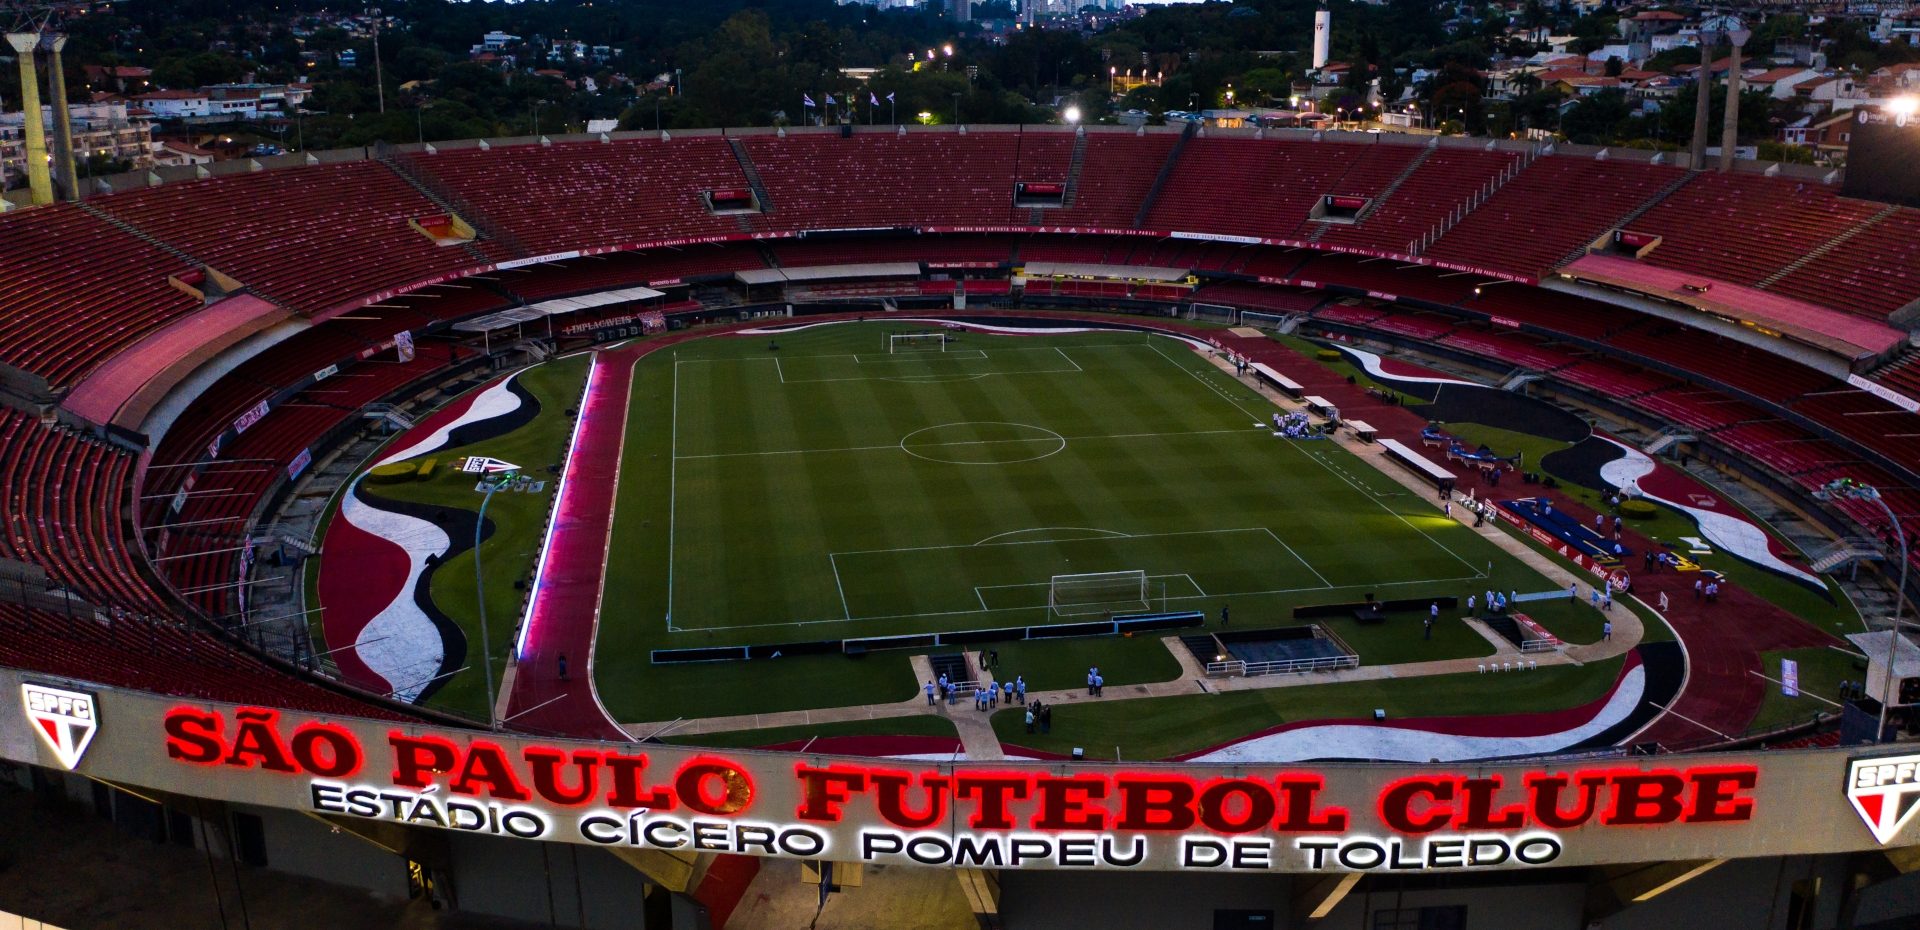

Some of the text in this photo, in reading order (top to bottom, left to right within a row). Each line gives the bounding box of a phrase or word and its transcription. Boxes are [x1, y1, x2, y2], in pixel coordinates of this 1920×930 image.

[29, 691, 90, 719] SPFC
[165, 708, 1757, 833] SÃO PAULO FUTEBOL CLUBE
[311, 781, 1561, 869] ESTÁDIO CÍCERO POMPEU DE TOLEDO
